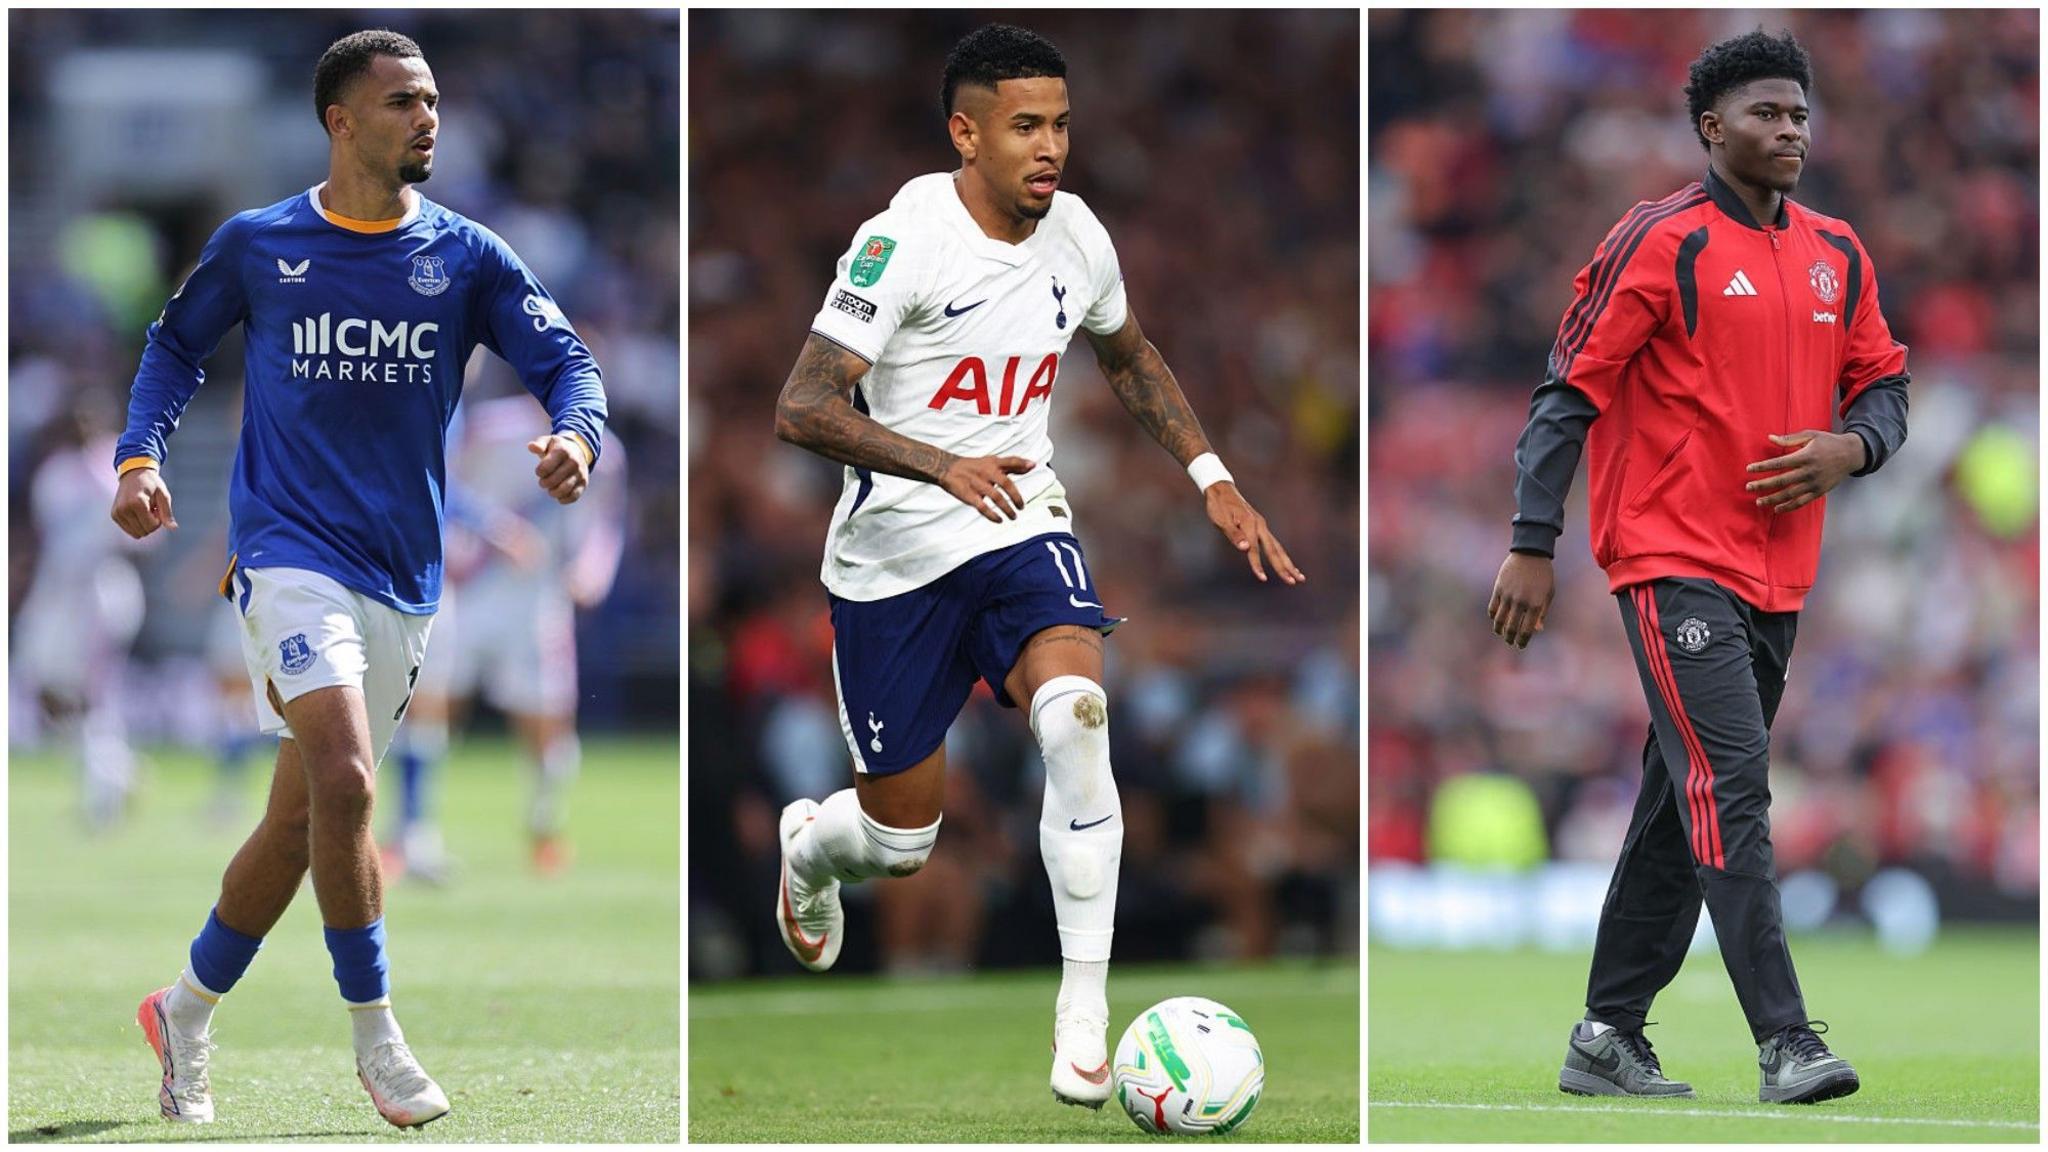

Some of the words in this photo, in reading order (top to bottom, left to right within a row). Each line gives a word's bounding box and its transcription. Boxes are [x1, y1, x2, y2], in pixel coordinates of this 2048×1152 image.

[845, 295, 873, 314] room
[335, 317, 440, 360] CMC
[292, 358, 433, 385] MARKETS
[928, 352, 1059, 417] AIA
[1045, 541, 1088, 592] 17
